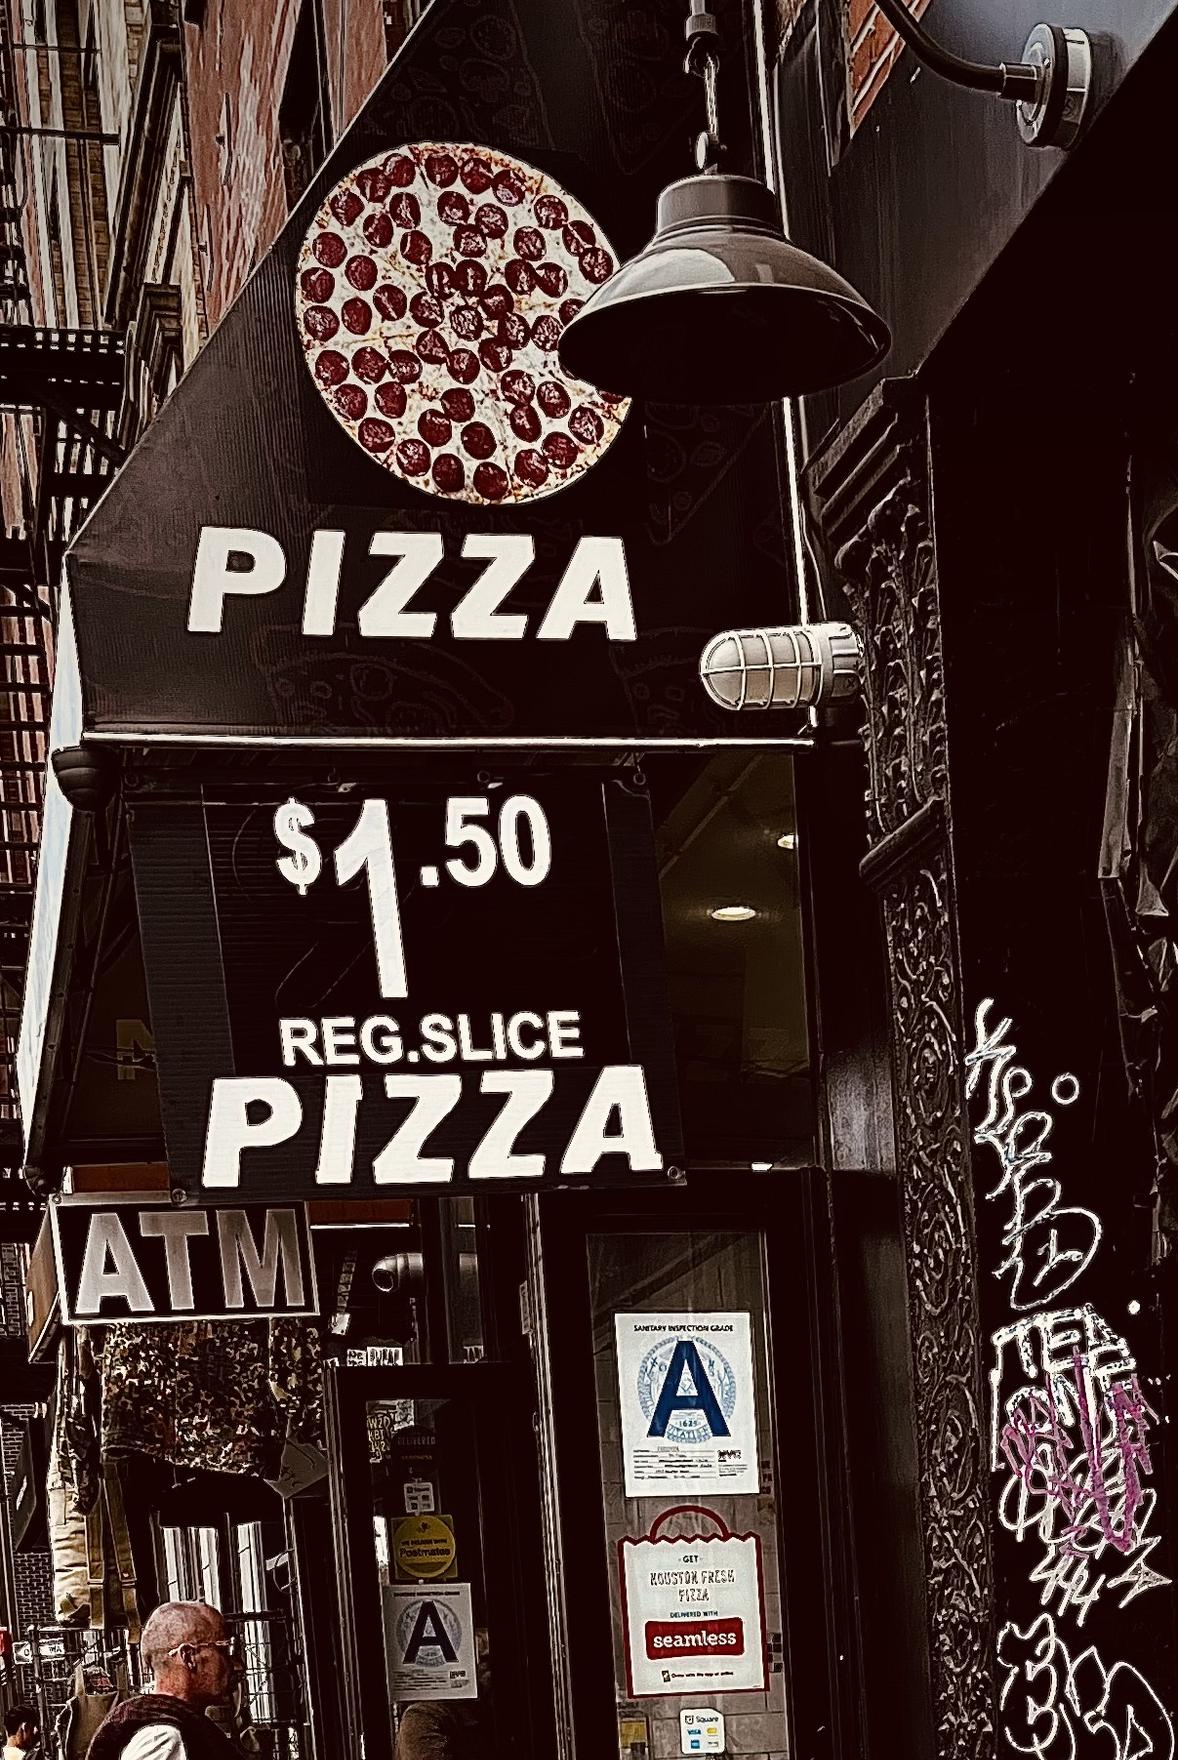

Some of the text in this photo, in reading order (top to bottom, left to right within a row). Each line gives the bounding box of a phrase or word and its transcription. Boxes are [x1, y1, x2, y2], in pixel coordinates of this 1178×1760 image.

[186, 526, 638, 641] PIZZA
[273, 795, 552, 999] $1.50
[279, 1011, 584, 1067] REG.SLICE
[202, 1065, 664, 1188] PIZZA
[75, 1208, 305, 1314] ATM
[633, 1324, 733, 1332] SANITARY INSPECTION GRADE
[647, 1341, 732, 1438] A
[650, 1569, 735, 1586] HOUSTON FRESH
[682, 1555, 699, 1563] GET
[678, 1588, 710, 1602] PIZZA
[402, 1600, 460, 1665] A
[670, 1611, 702, 1619] DELIVERED
[653, 1630, 737, 1649] seamless
[695, 1715, 719, 1724] Square
